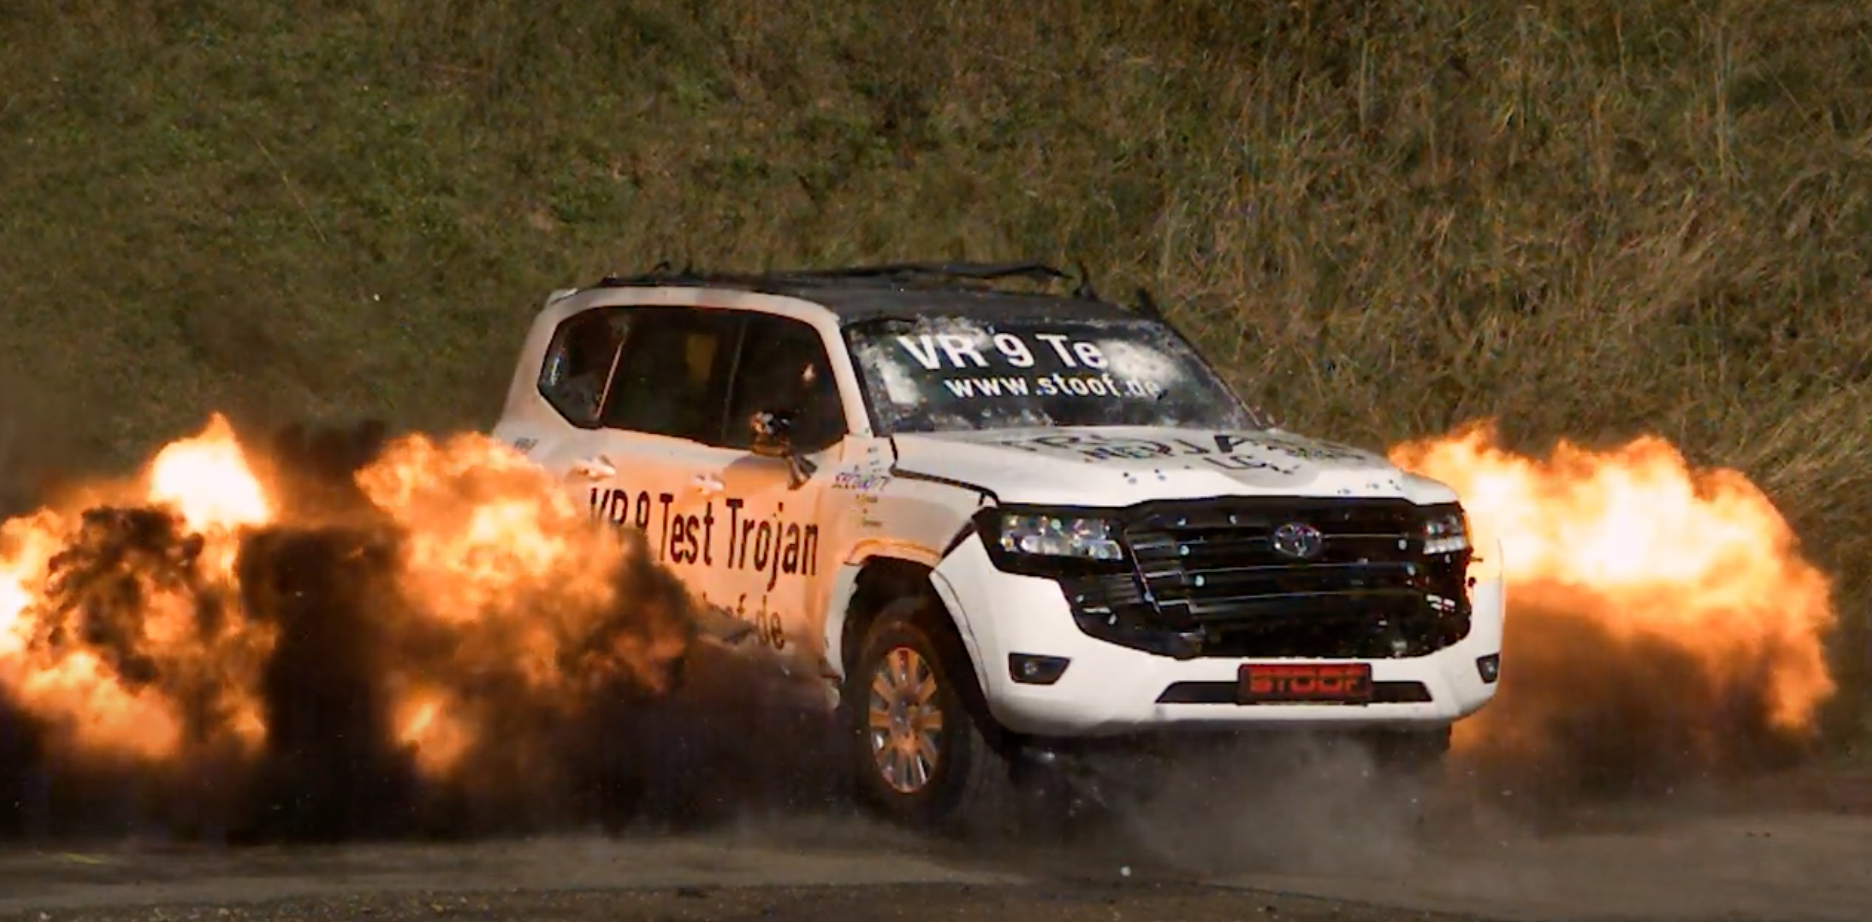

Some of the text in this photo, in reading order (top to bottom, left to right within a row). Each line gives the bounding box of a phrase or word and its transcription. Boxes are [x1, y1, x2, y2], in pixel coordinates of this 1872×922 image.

[897, 333, 990, 370] VR
[993, 332, 1035, 368] 9
[945, 372, 1162, 399] www.stoof.de
[659, 492, 714, 567] Test
[725, 498, 818, 591] Trojan
